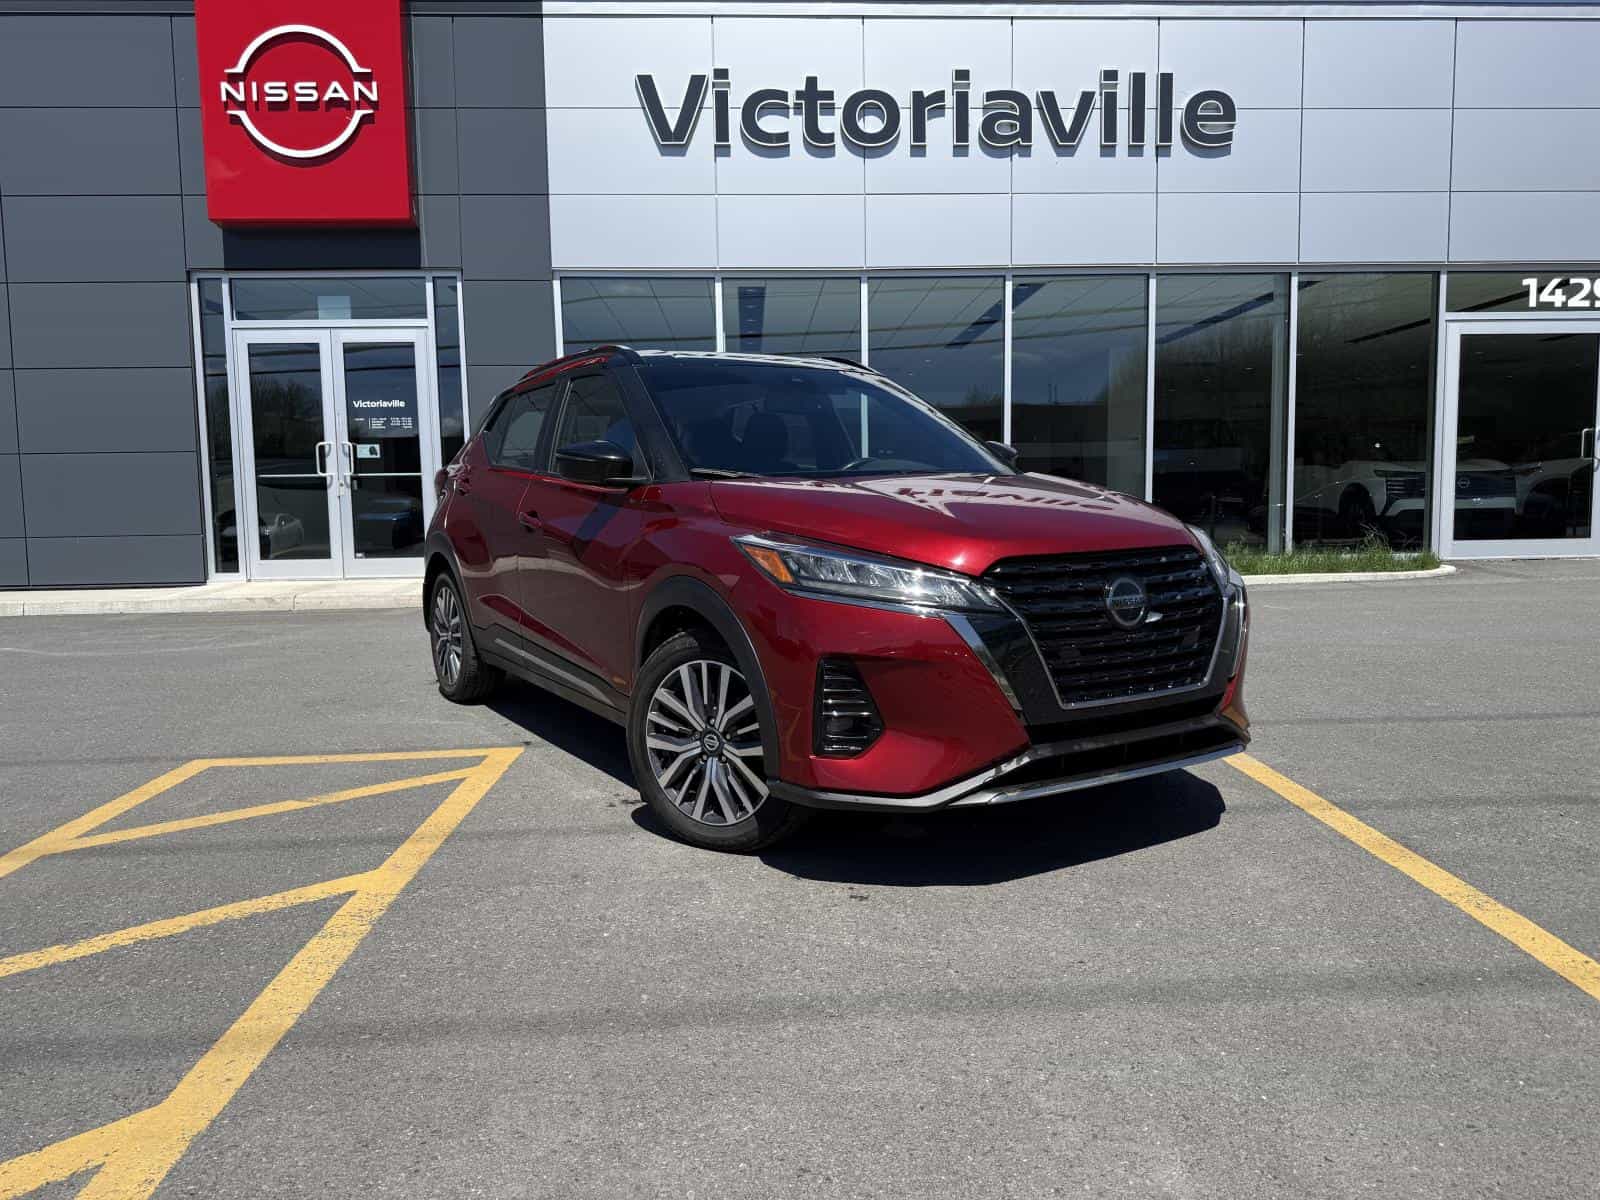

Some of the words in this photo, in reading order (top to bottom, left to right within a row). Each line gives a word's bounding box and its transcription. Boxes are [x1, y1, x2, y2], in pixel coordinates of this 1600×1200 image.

[220, 81, 378, 102] NISSAN
[635, 68, 1237, 147] Victoriaville
[352, 399, 406, 408] Victoriaville
